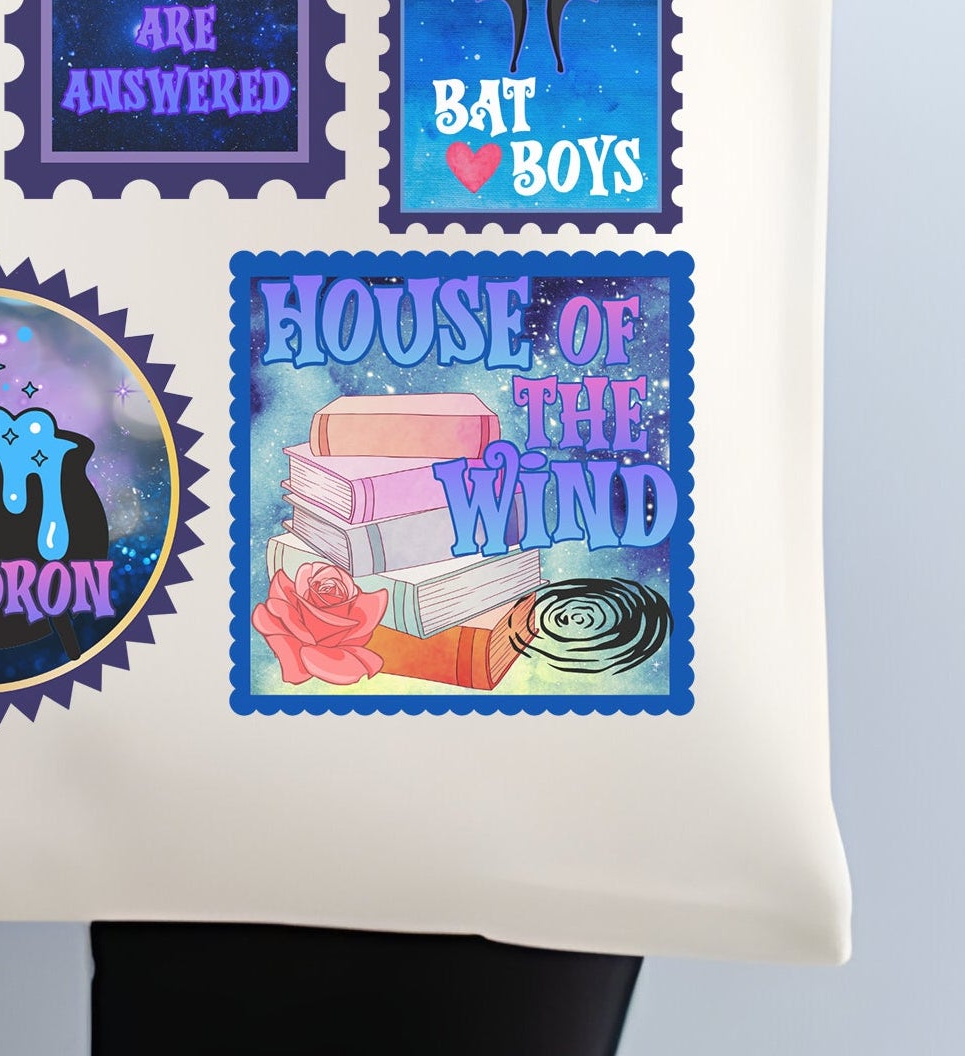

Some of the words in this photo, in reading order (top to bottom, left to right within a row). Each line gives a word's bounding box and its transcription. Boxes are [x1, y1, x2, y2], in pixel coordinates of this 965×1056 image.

[135, 5, 217, 53] ARE
[60, 65, 292, 118] ANSWERED
[433, 78, 535, 135] BAT
[512, 135, 645, 196] BOYS
[259, 274, 532, 369] HOUSE
[558, 295, 640, 365] OF
[513, 375, 648, 453] THE
